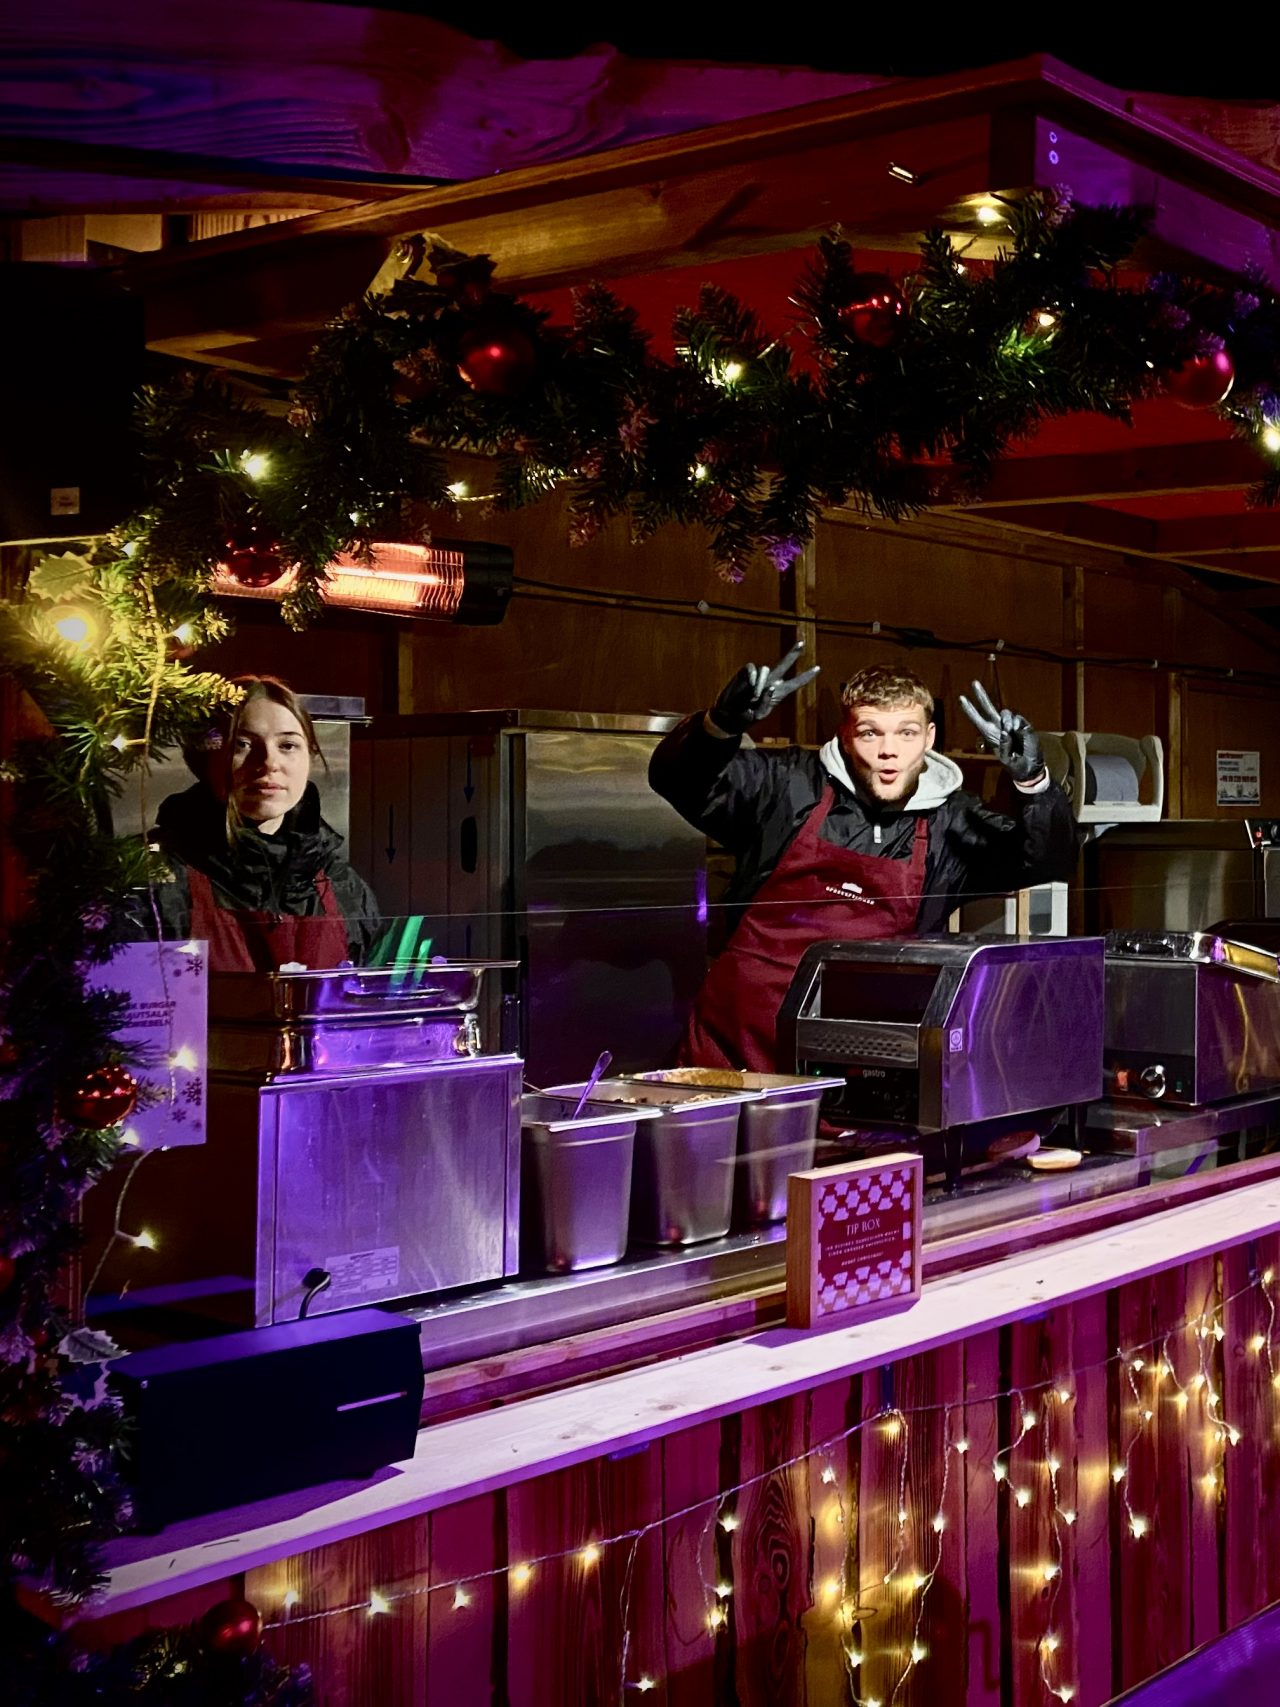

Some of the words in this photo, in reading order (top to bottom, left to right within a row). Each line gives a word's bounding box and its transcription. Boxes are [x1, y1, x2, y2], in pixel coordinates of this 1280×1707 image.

[862, 1068, 886, 1078] gastro
[846, 1223, 859, 1237] TIP
[862, 1218, 880, 1232] BOX
